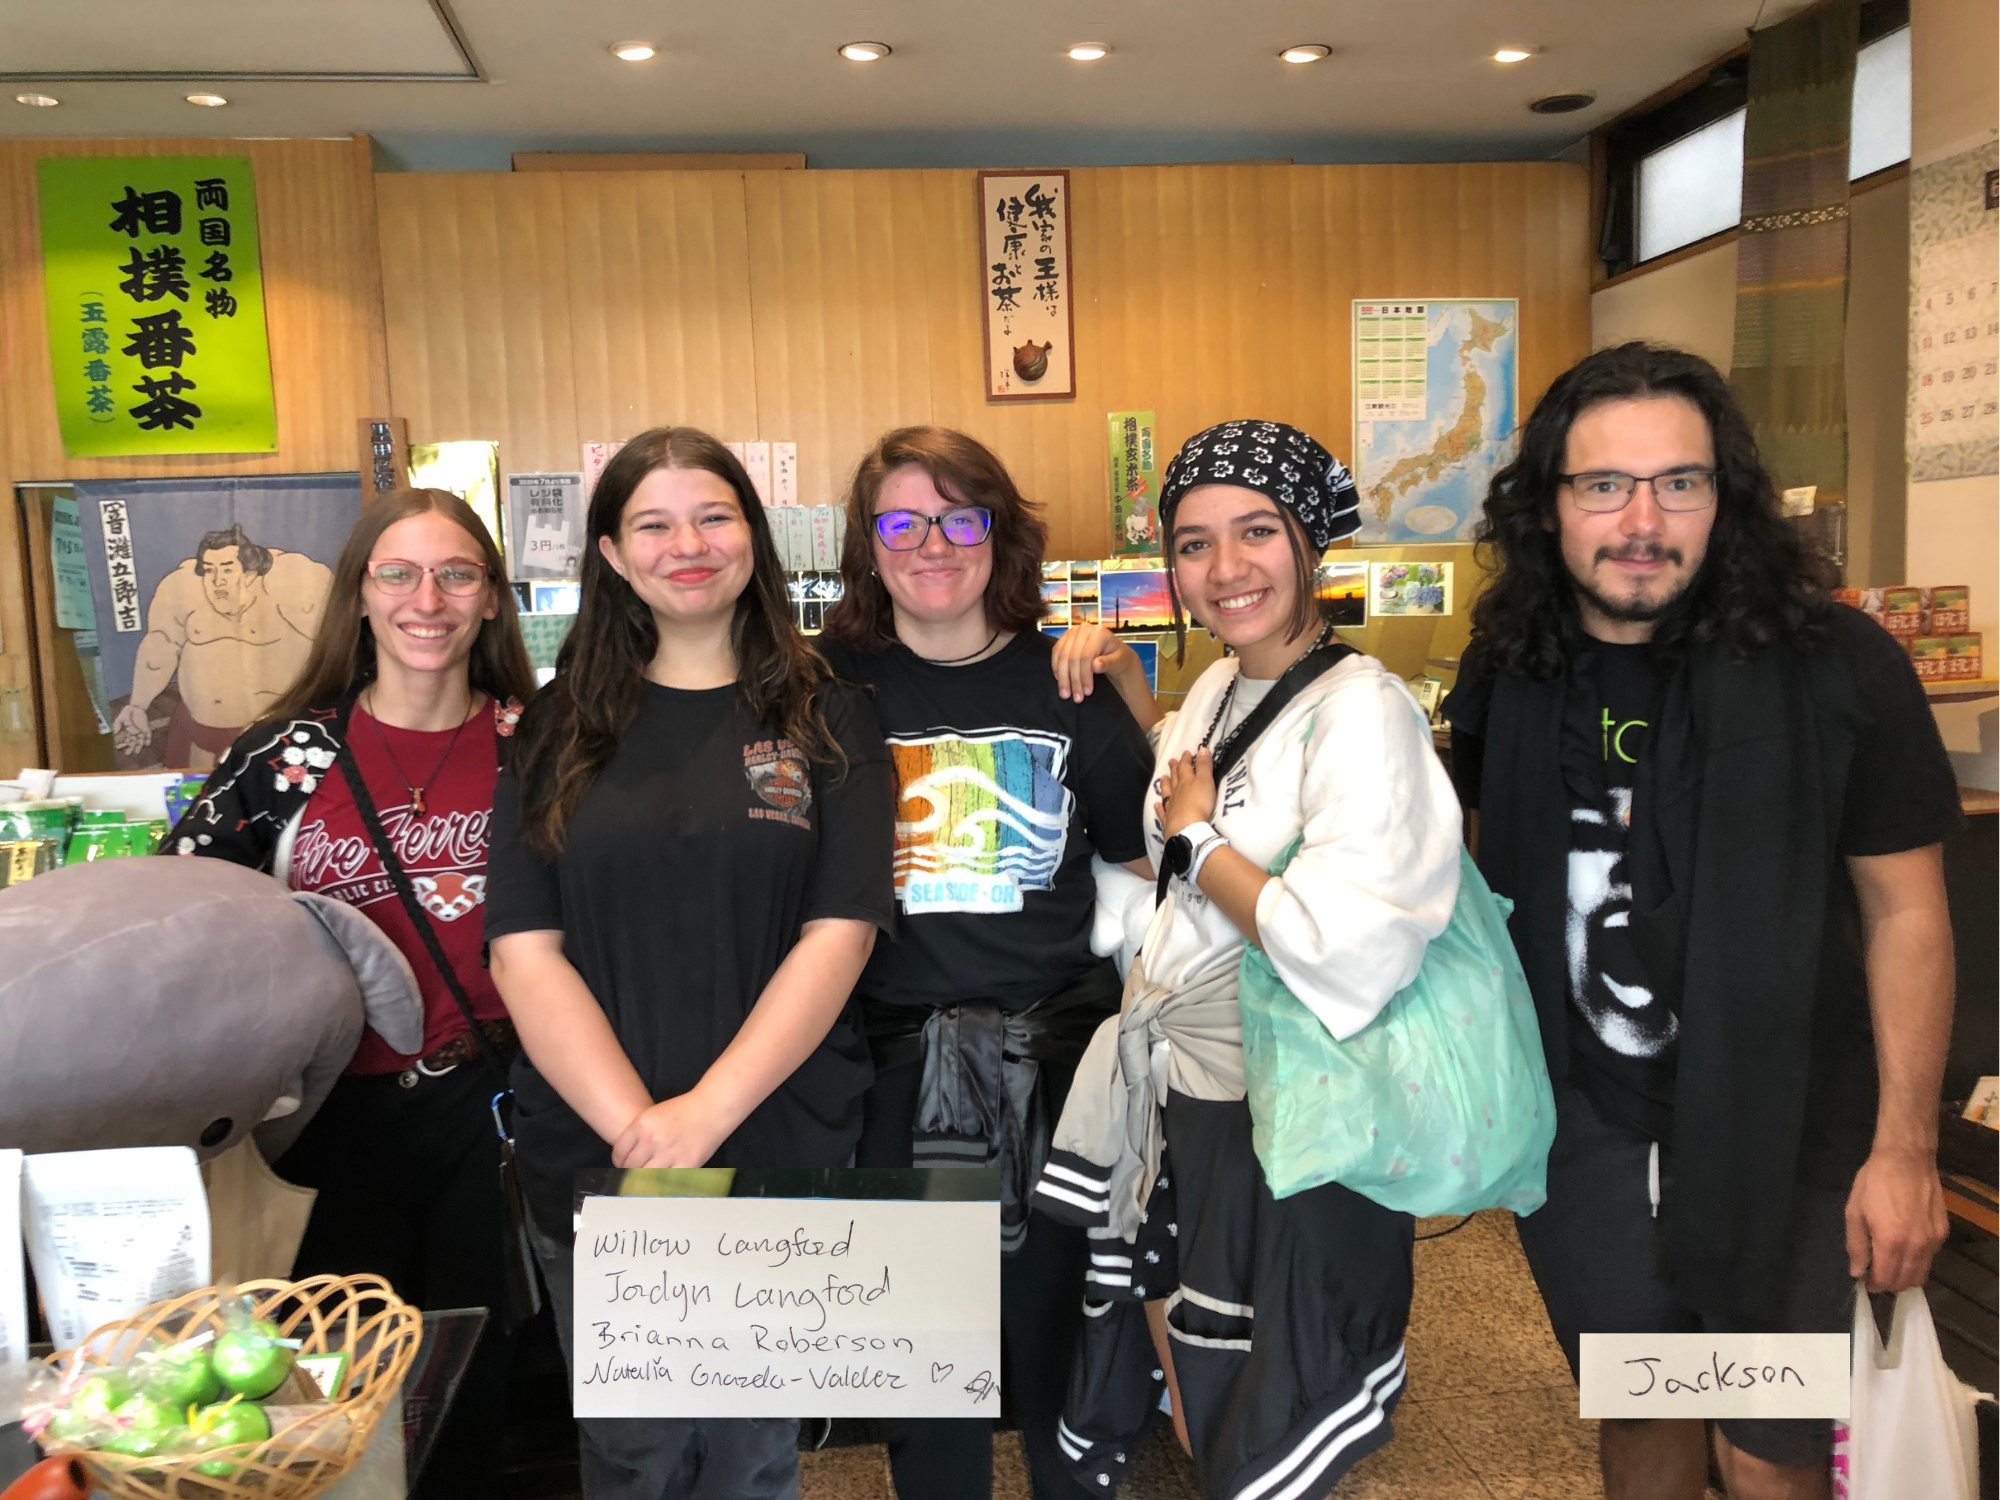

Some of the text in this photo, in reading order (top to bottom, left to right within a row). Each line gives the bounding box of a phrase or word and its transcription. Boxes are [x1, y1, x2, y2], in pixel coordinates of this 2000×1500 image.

[194, 177, 238, 319] 両国名物
[1946, 292, 1955, 305] 5
[1967, 287, 1976, 300] 6
[1991, 281, 1998, 294] 7
[110, 185, 202, 431] 相撲番茶
[1382, 306, 1425, 314] 日本地図
[1943, 331, 1956, 345] 12
[1964, 326, 1978, 340] 13
[1922, 363, 1997, 387] 18 19 20 21
[1920, 402, 1998, 425] 25 26 27 28
[1124, 416, 1139, 492] 相撲玄米茶
[743, 740, 773, 757] LAS
[991, 884, 1015, 903] OR
